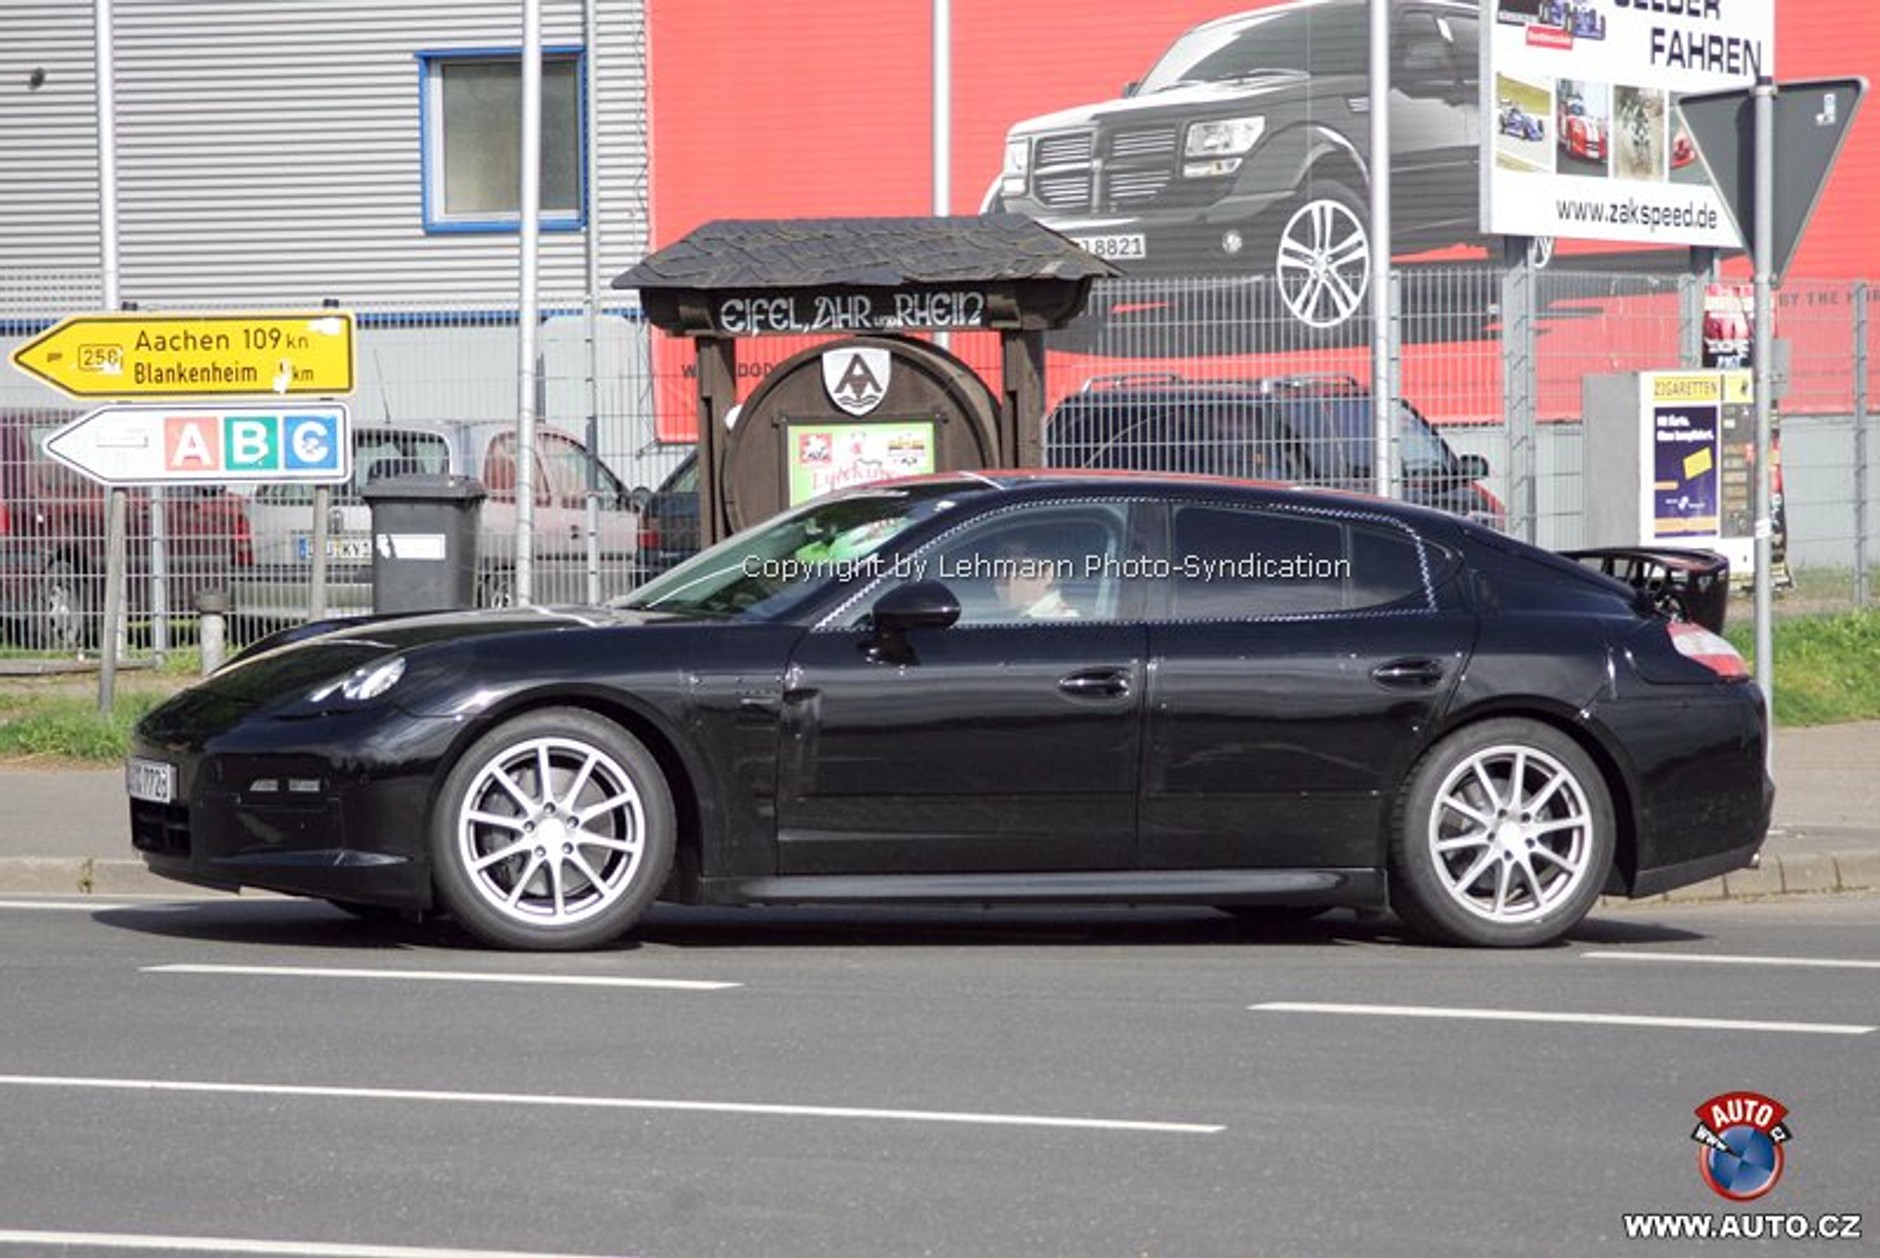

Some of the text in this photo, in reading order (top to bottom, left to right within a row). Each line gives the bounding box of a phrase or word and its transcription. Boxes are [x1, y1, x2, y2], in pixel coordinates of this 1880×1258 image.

[1651, 27, 1761, 77] FAHREN
[1556, 198, 1718, 232] www.zakspeed.de
[134, 329, 229, 351] Aachen
[243, 327, 282, 350] 109
[134, 361, 257, 385] Blankenheim
[1654, 377, 1717, 397] ZIGARETTEN
[171, 422, 214, 467] A
[232, 421, 269, 463] B
